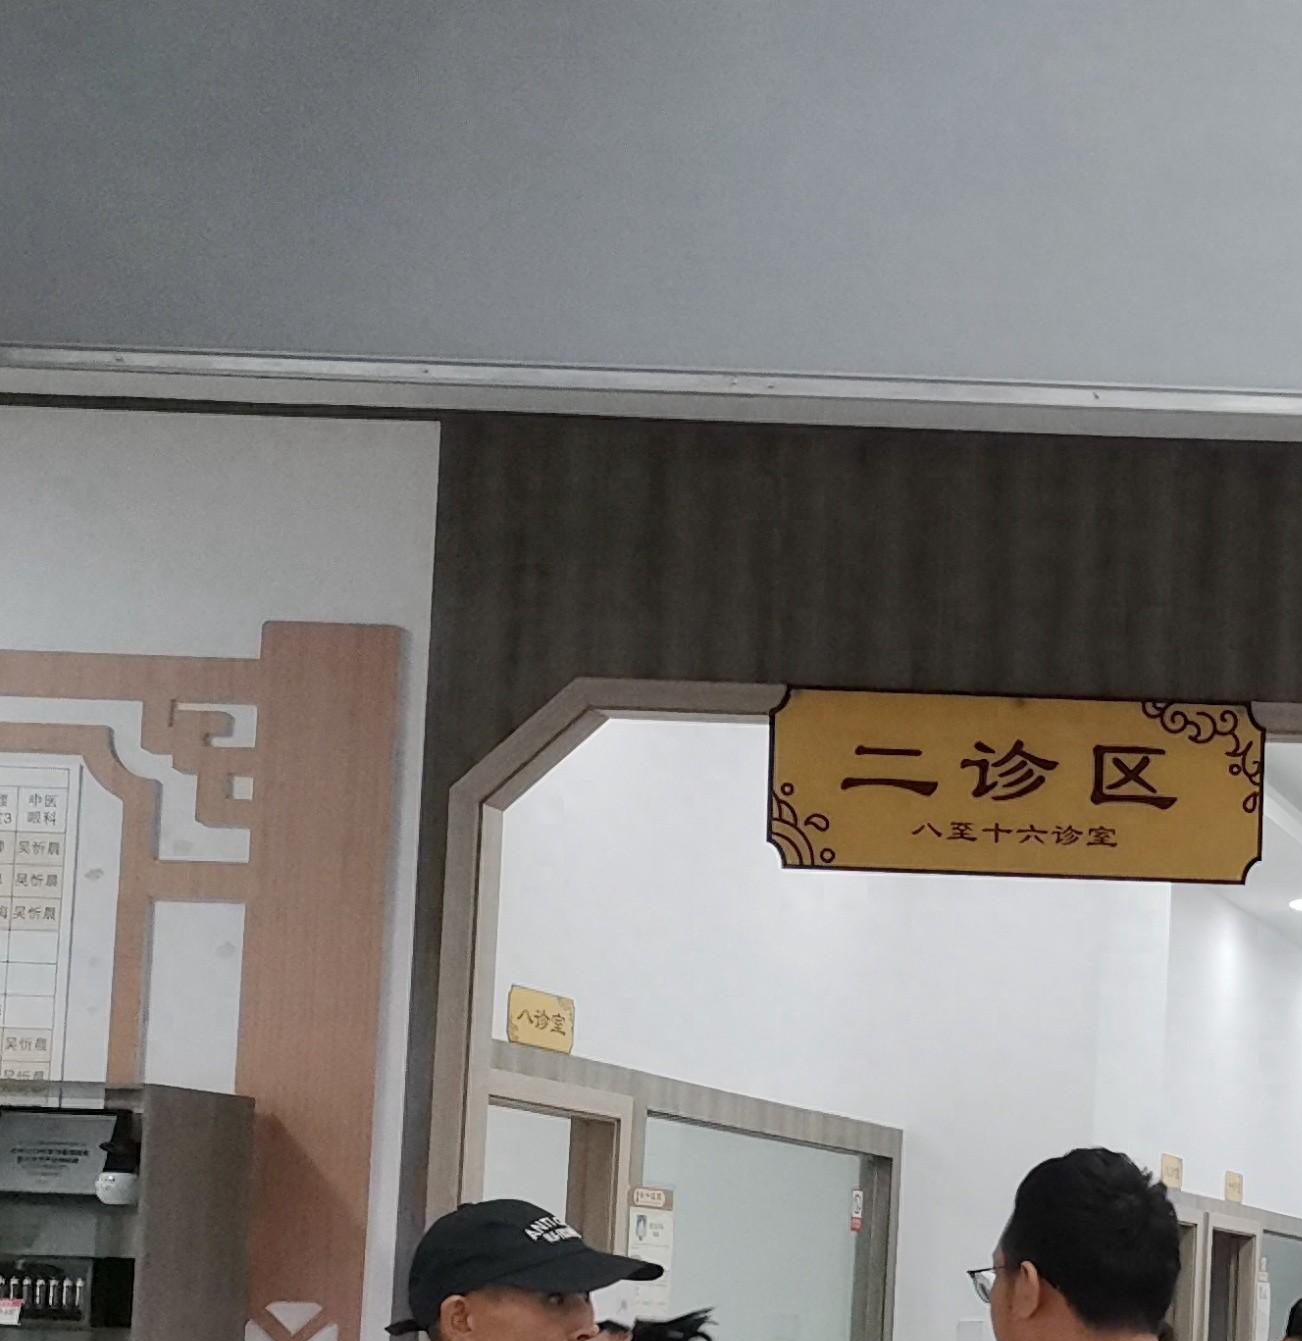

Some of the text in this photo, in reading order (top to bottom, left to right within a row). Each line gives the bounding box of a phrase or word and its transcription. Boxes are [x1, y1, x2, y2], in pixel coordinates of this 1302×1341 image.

[841, 739, 1178, 811] 二诊区
[911, 822, 1118, 848] 八至十六诊室
[517, 1008, 567, 1036] 八诊室
